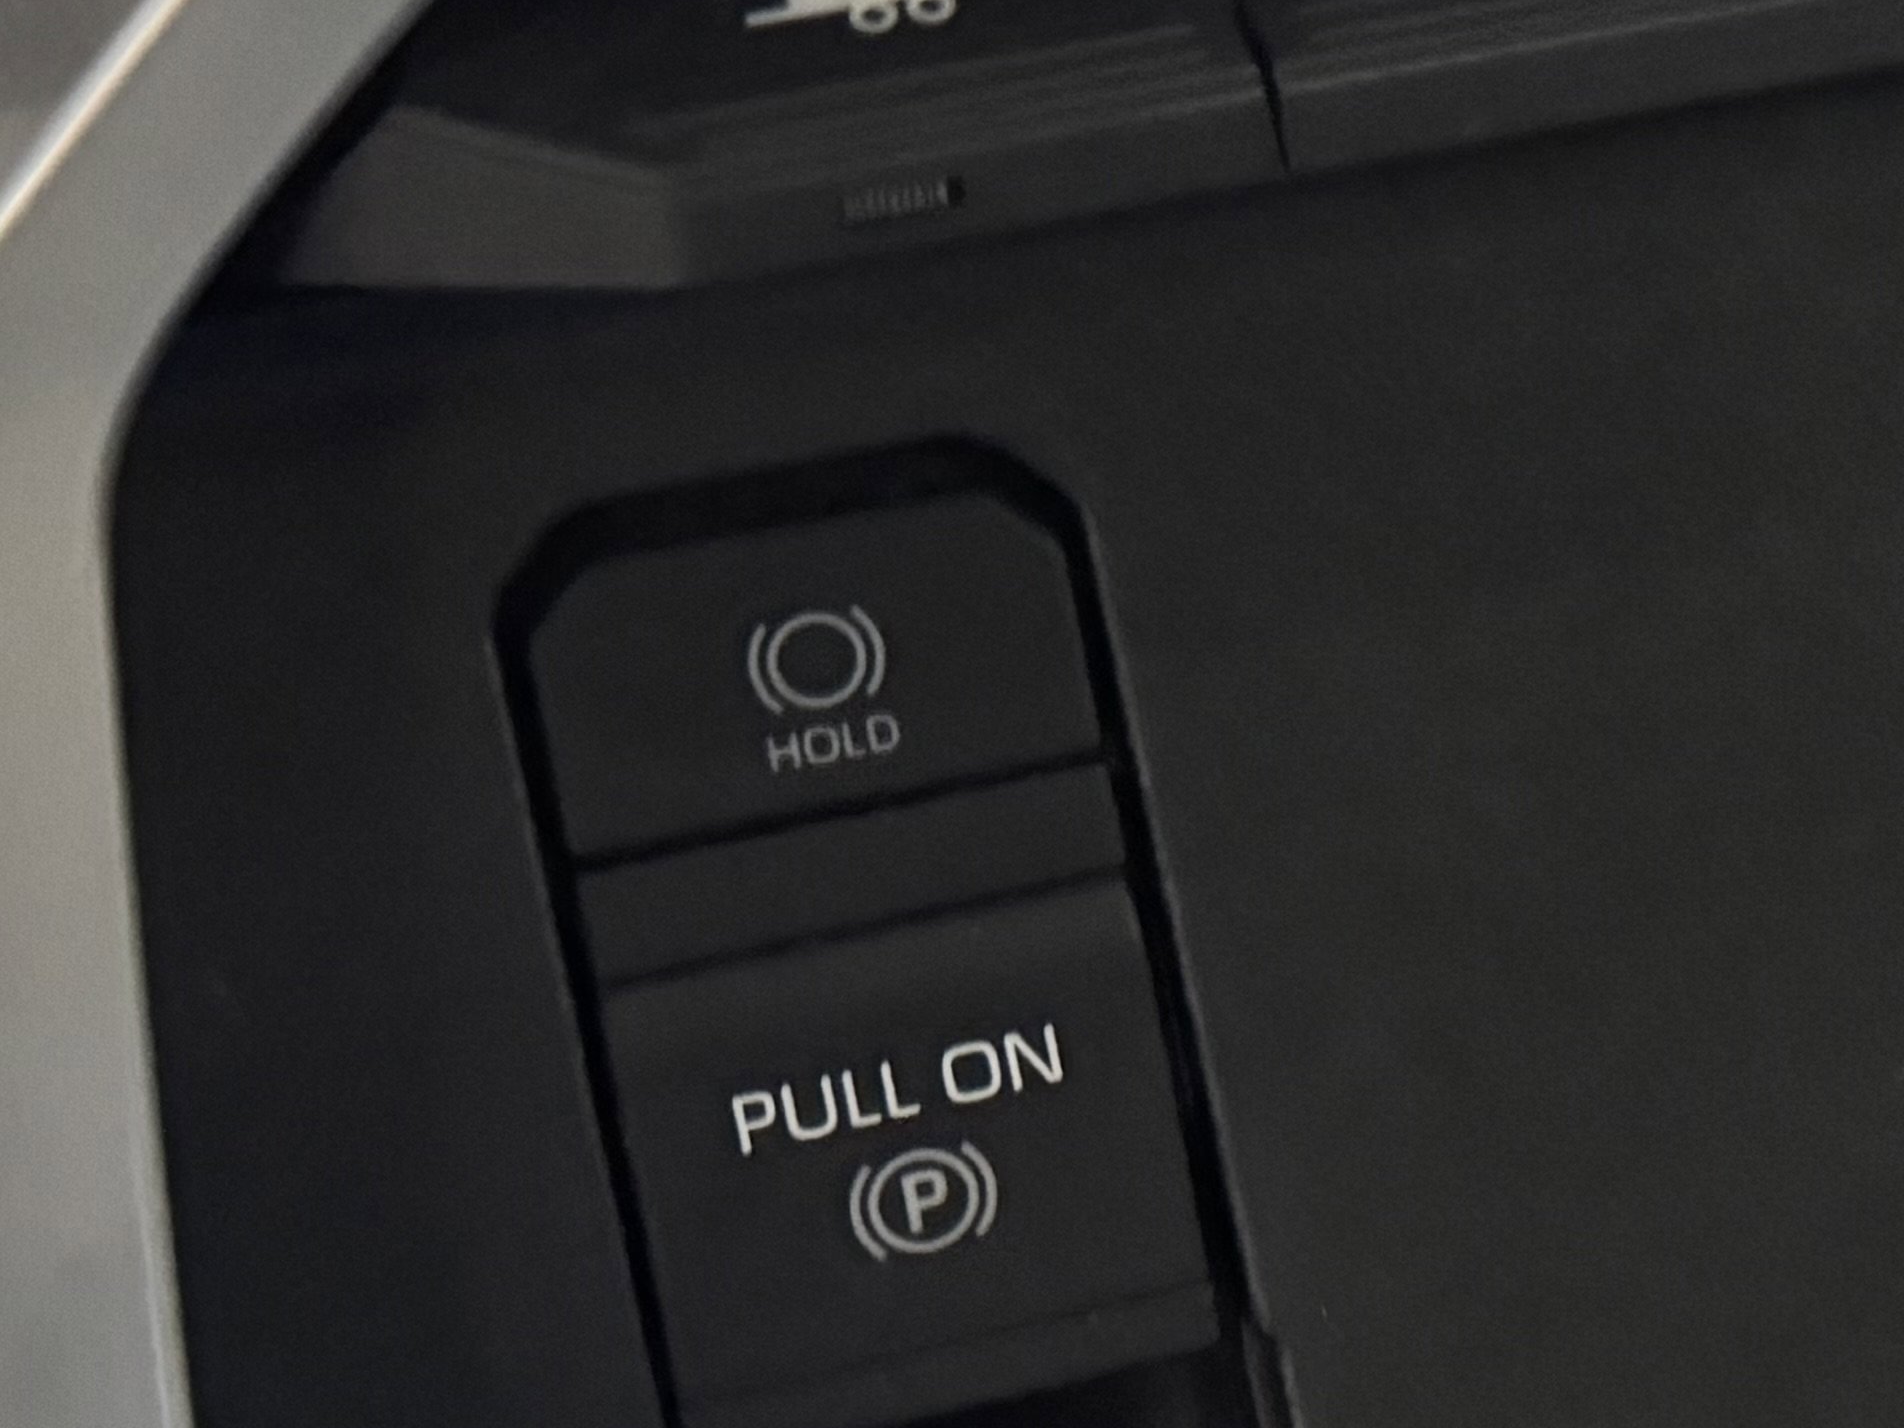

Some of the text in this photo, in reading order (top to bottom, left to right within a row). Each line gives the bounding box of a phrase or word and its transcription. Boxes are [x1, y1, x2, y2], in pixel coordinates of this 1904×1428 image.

[766, 712, 902, 774] HOLD
[729, 1021, 1066, 1157] PULL ON
